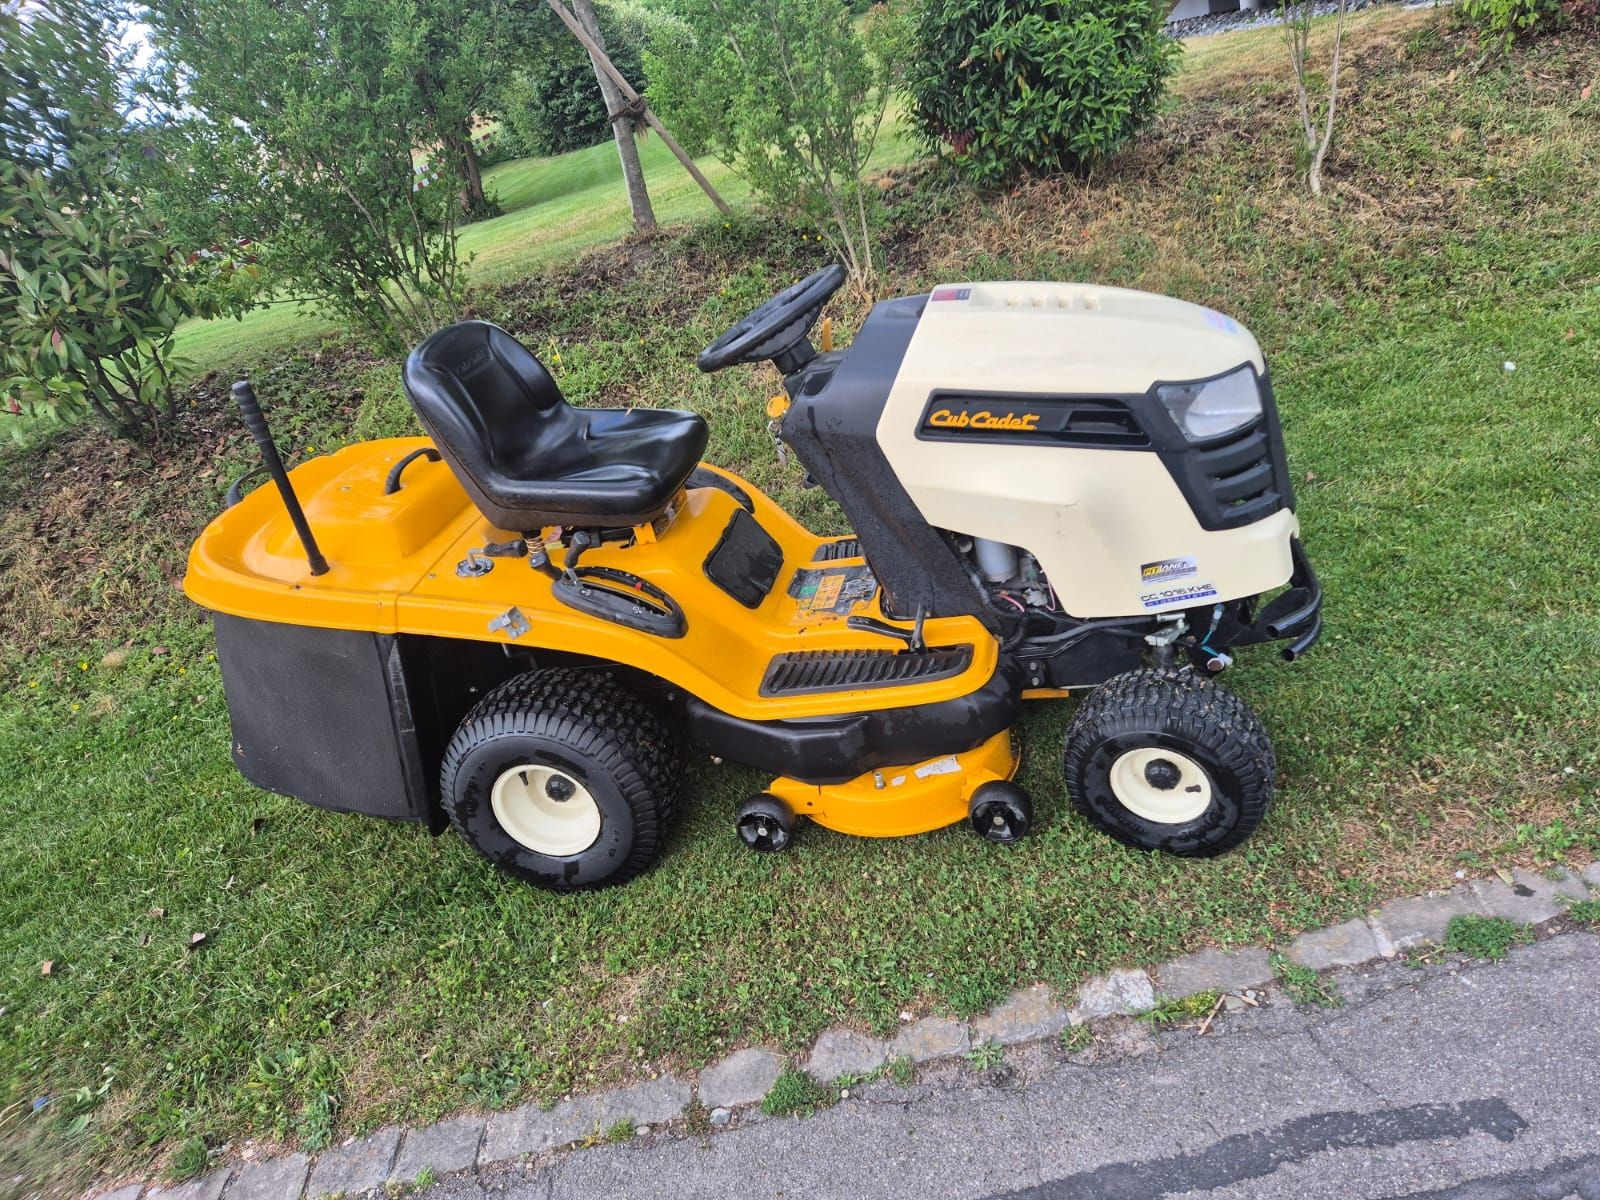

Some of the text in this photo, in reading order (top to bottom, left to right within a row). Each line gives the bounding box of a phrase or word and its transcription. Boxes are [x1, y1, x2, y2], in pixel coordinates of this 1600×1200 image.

[929, 409, 1040, 431] Cub Cadet
[1140, 593, 1159, 602] CC
